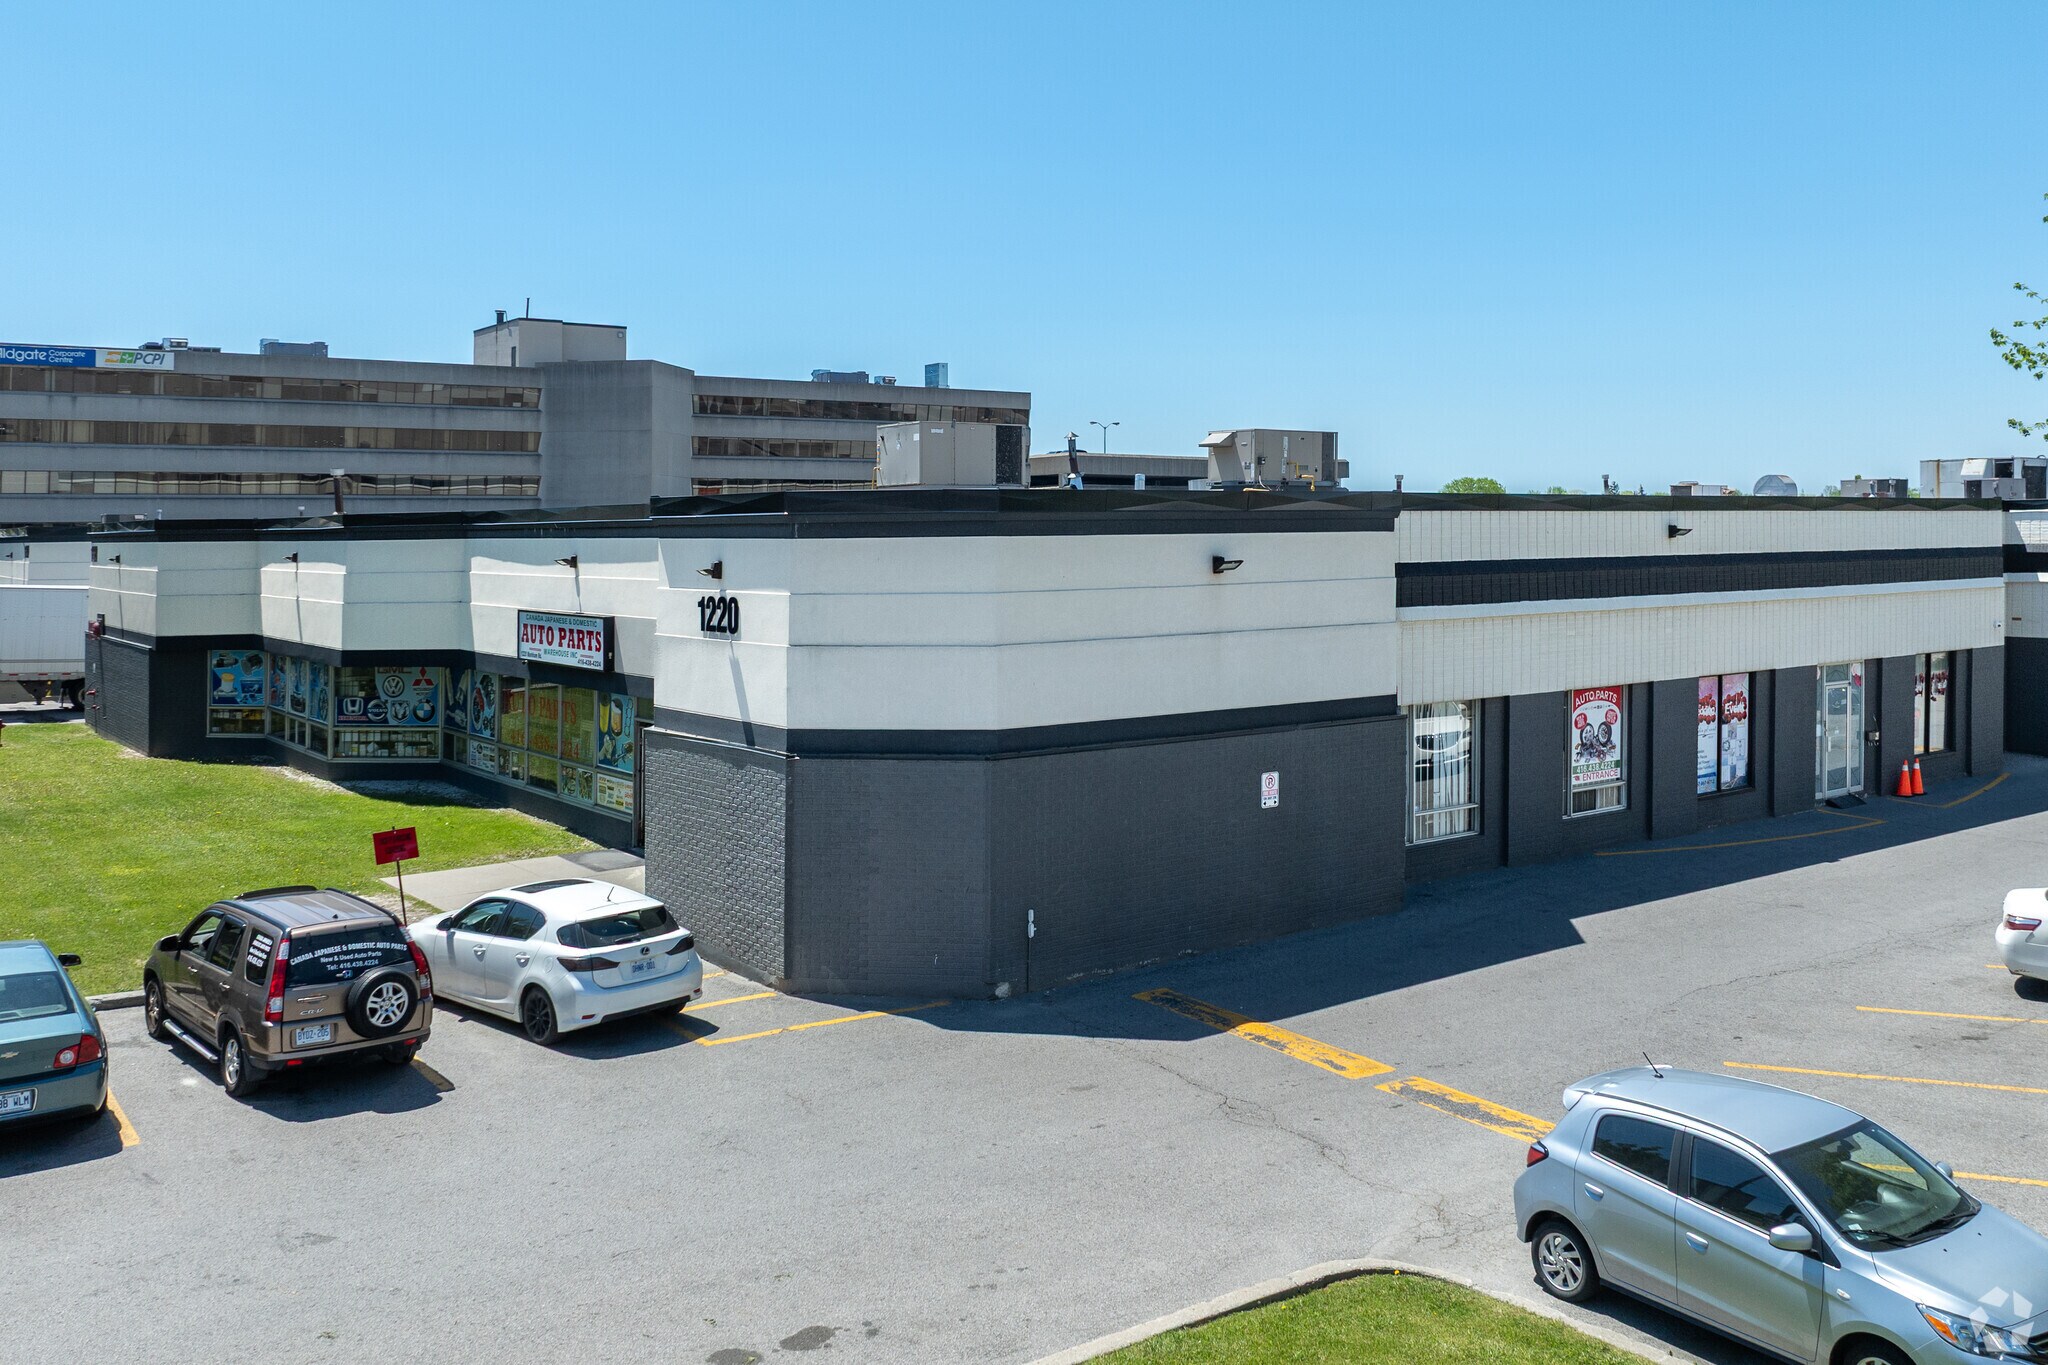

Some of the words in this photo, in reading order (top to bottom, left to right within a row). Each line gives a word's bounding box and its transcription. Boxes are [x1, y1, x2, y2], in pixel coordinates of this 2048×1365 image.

[48, 349, 86, 358] Corporate
[133, 352, 166, 365] PCPI
[48, 356, 74, 364] Centre
[526, 613, 544, 621] CANADA
[544, 616, 568, 625] JAPANESE
[572, 619, 597, 628] DOMESTIC
[697, 595, 739, 635] 1220
[521, 623, 555, 646] AUTO
[557, 627, 602, 653] PARTS
[543, 648, 570, 658] WAREHOUSE
[1575, 690, 1595, 708] AUTO
[1595, 690, 1618, 703] PARTS
[1576, 761, 1615, 773] 416.438.4224
[1582, 769, 1618, 781] ENTRANCE
[290, 952, 314, 966] CANADA
[313, 944, 342, 958] JAPANESE
[342, 944, 347, 952] &
[347, 942, 376, 951] DOMESTIC
[390, 942, 408, 952] PARTS
[320, 956, 333, 964] New
[339, 952, 354, 961] Used
[354, 951, 368, 959] Auto
[367, 950, 382, 958] Parts
[300, 1008, 325, 1016] CR-V
[13, 1095, 30, 1107] WLM
